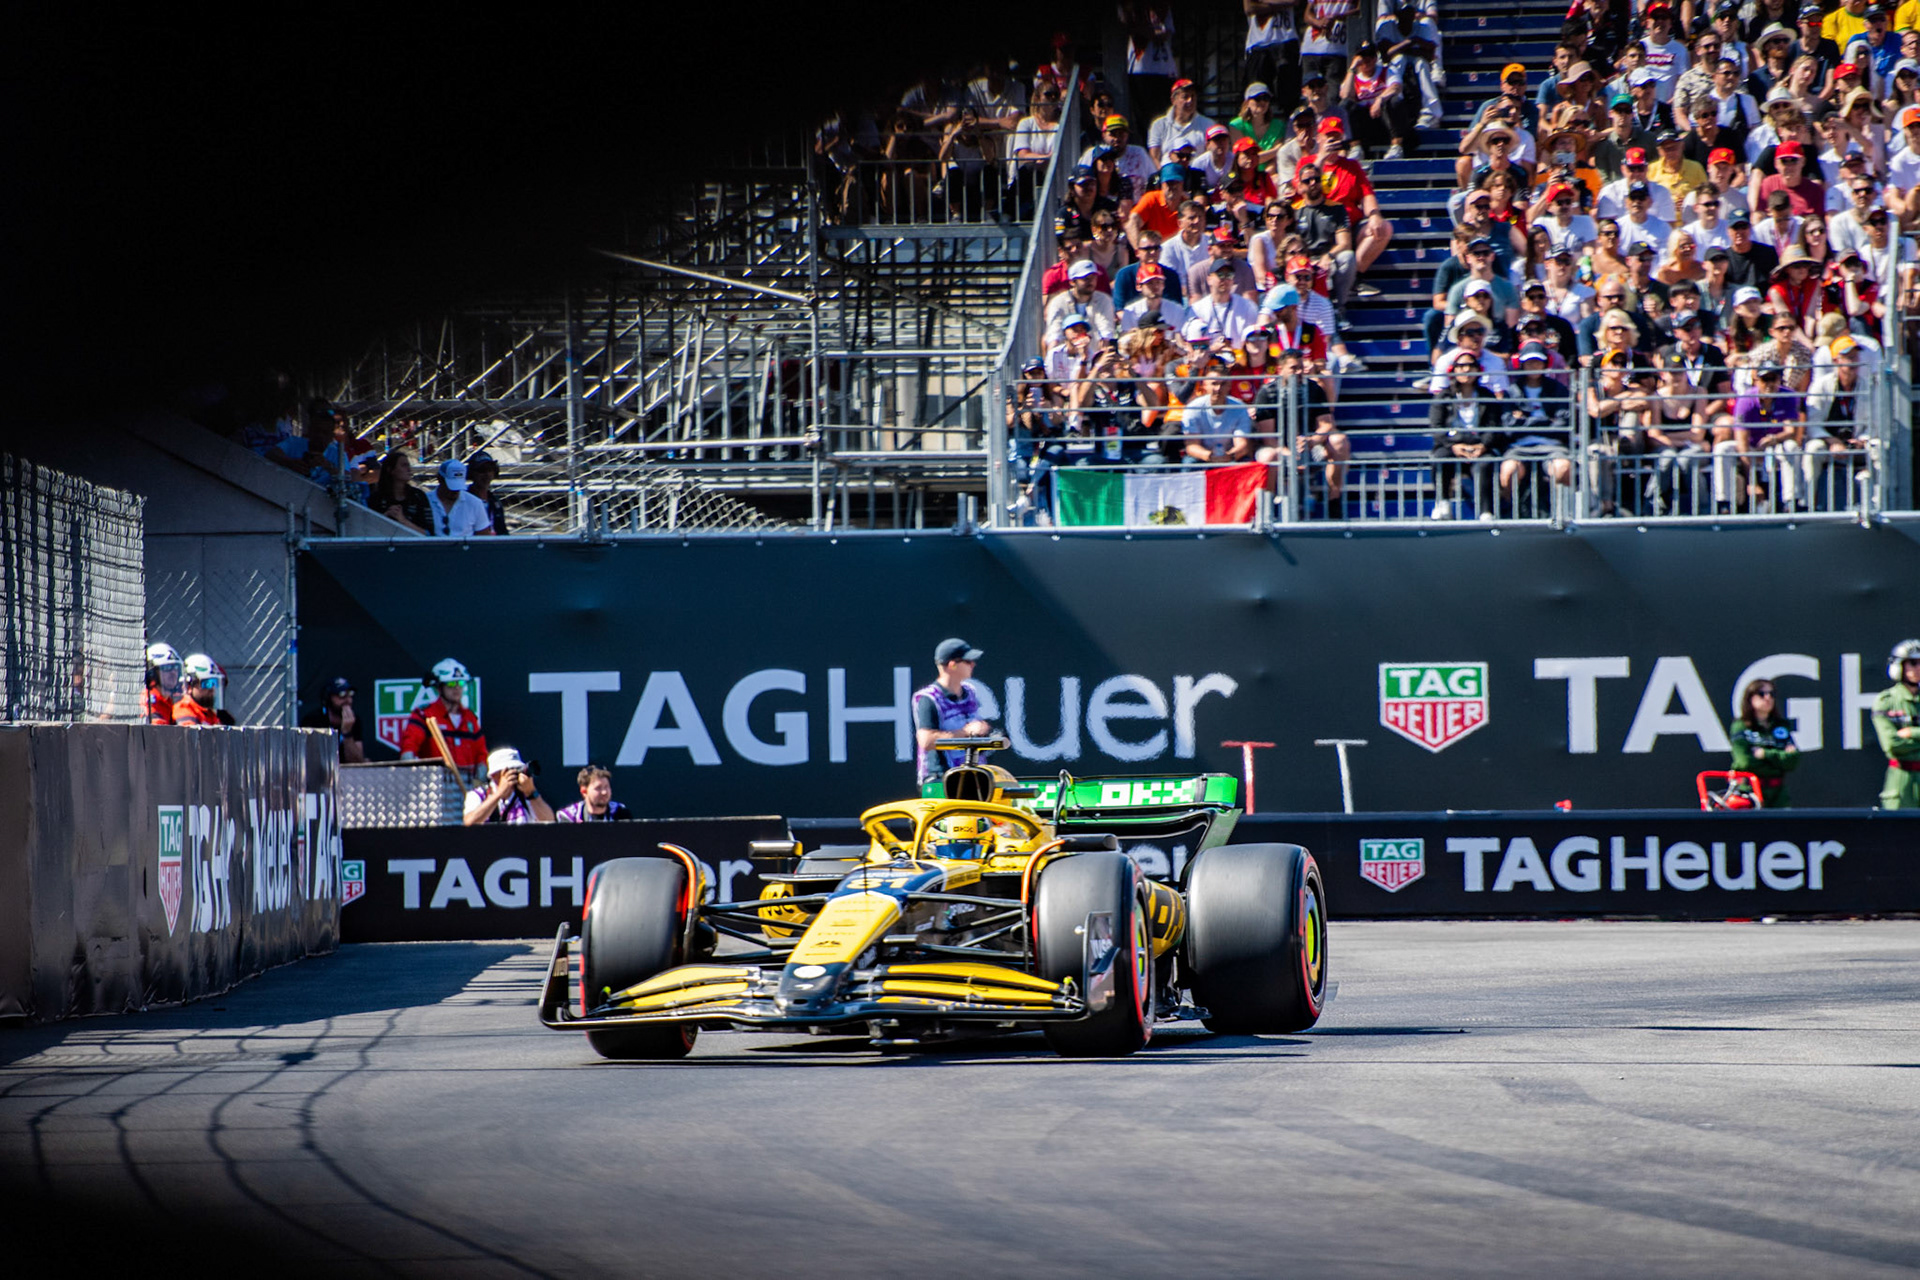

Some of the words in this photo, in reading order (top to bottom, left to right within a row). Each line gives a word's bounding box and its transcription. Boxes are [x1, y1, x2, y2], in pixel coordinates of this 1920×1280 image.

[1389, 668, 1478, 697] TAG
[384, 685, 469, 711] TA
[1387, 702, 1483, 746] HEUER
[1101, 782, 1196, 806] OKX
[161, 815, 182, 853] TAG
[1366, 843, 1418, 859] TAG
[846, 877, 909, 890] 81
[1363, 862, 1421, 888] HEUER
